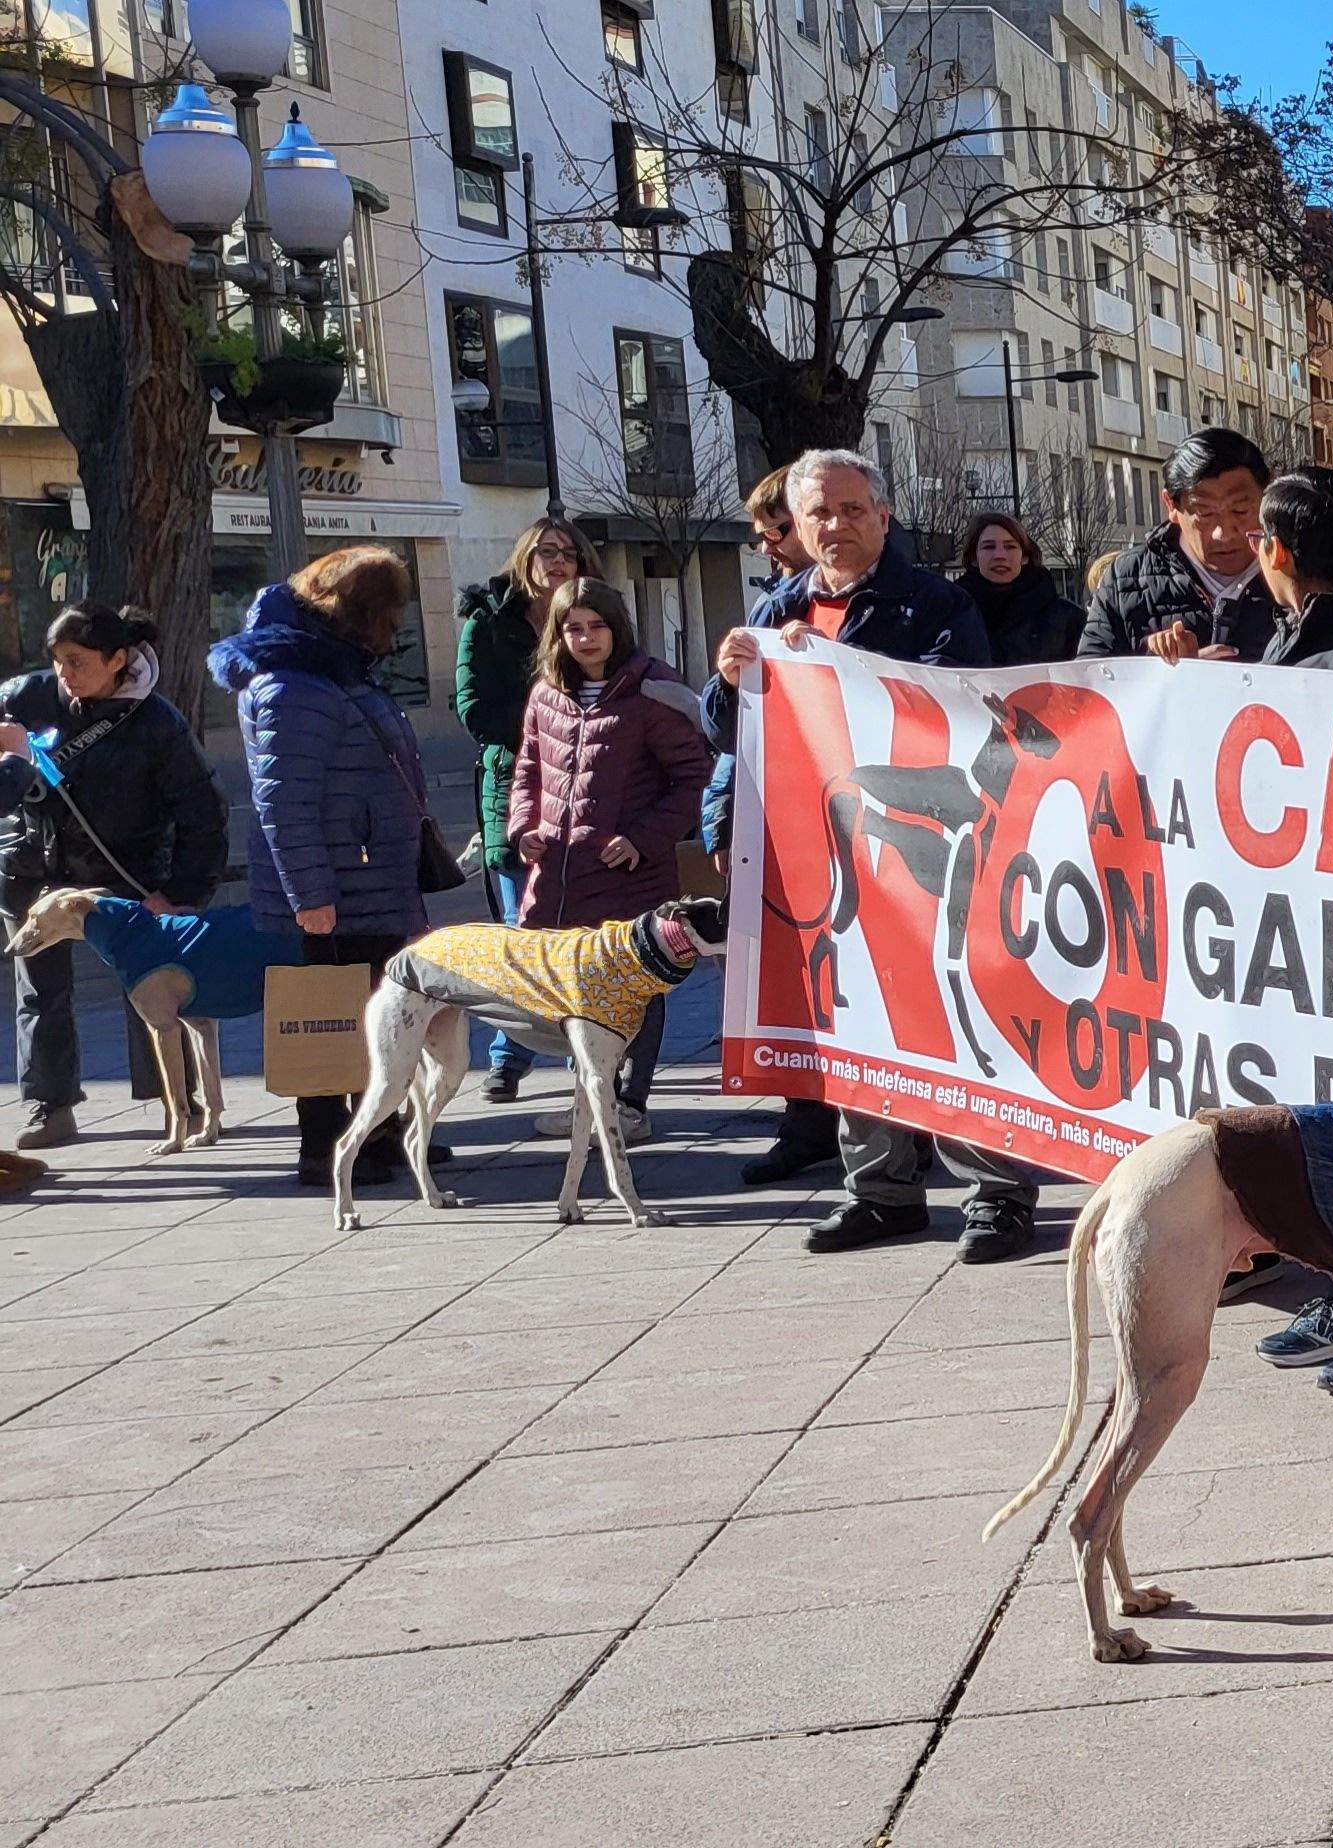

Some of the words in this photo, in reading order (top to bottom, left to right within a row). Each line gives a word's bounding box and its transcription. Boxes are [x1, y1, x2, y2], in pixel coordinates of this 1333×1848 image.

[302, 516, 326, 529] RANJA
[328, 516, 349, 529] ANITA
[1090, 770, 1125, 838] A
[1137, 774, 1196, 849] LA
[1000, 852, 1159, 982] CON
[280, 1021, 299, 1035] LOS
[303, 1019, 357, 1034] VAQUEROS
[1011, 1015, 1042, 1073] Y
[1067, 998, 1277, 1119] OTRAS
[754, 1045, 828, 1074] Cuanto
[831, 1057, 861, 1082] más
[863, 1067, 932, 1101] indefensa
[935, 1084, 967, 1111] está
[970, 1094, 996, 1118] una
[999, 1101, 1058, 1141] criatura,
[1060, 1119, 1090, 1147] más
